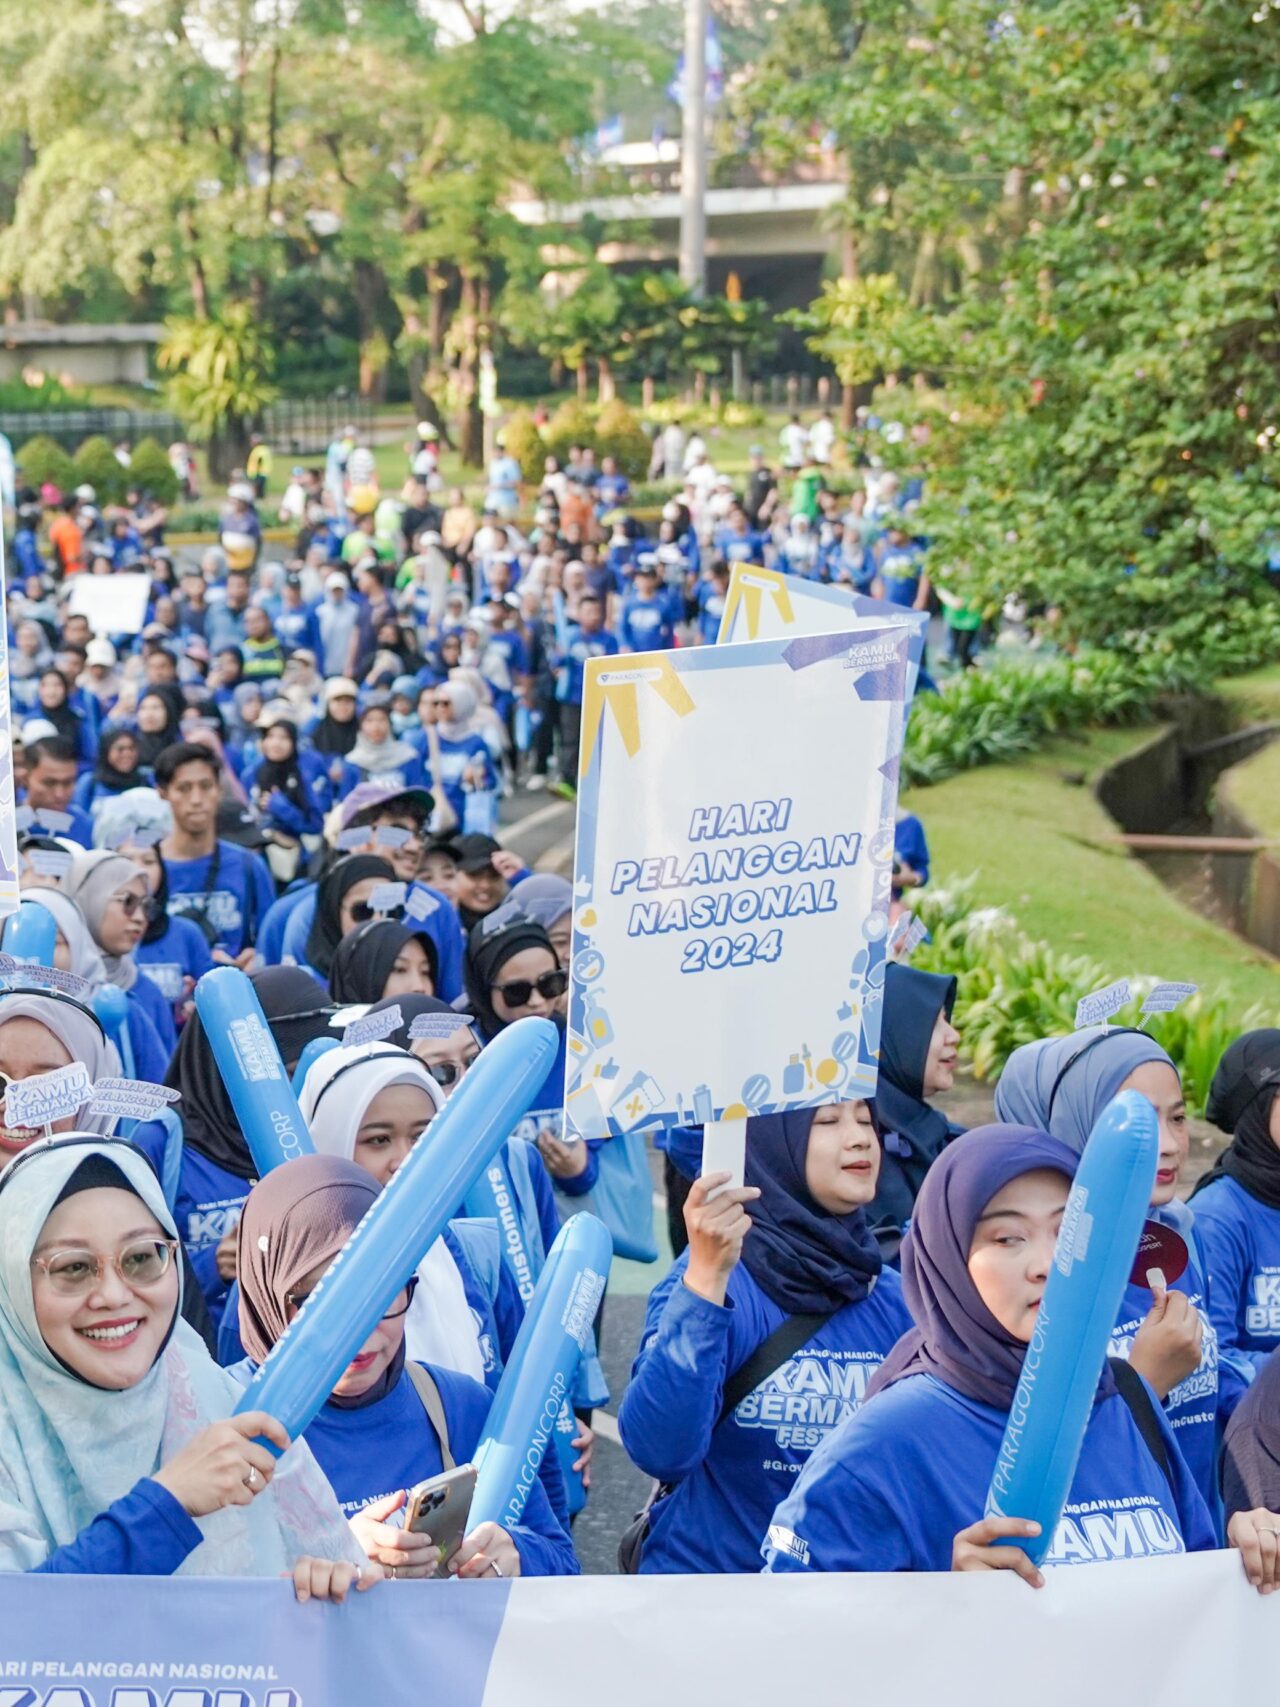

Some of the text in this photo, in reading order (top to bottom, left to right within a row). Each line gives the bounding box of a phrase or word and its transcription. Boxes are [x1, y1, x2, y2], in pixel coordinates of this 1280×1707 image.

[848, 642, 895, 659] KAMU
[688, 797, 792, 842] HARI
[610, 833, 862, 895] PELANGGAN
[627, 879, 838, 937] NASIONAL
[680, 929, 783, 974] 2024
[229, 1019, 269, 1082] KAMU
[7, 1088, 94, 1126] BERMAKNA
[9, 1073, 87, 1111] KAMU
[92, 1103, 152, 1118] NASIONAL
[565, 1267, 599, 1342] KAMU
[755, 1358, 881, 1400] KAM
[992, 1300, 1051, 1495] PARAGONCORP
[736, 1394, 863, 1427] BERMA
[505, 1372, 566, 1530] ARAGONCORP
[1046, 1508, 1184, 1560] AMU
[31, 1660, 164, 1679] PELANGGAN
[168, 1663, 279, 1681] NASIONAL
